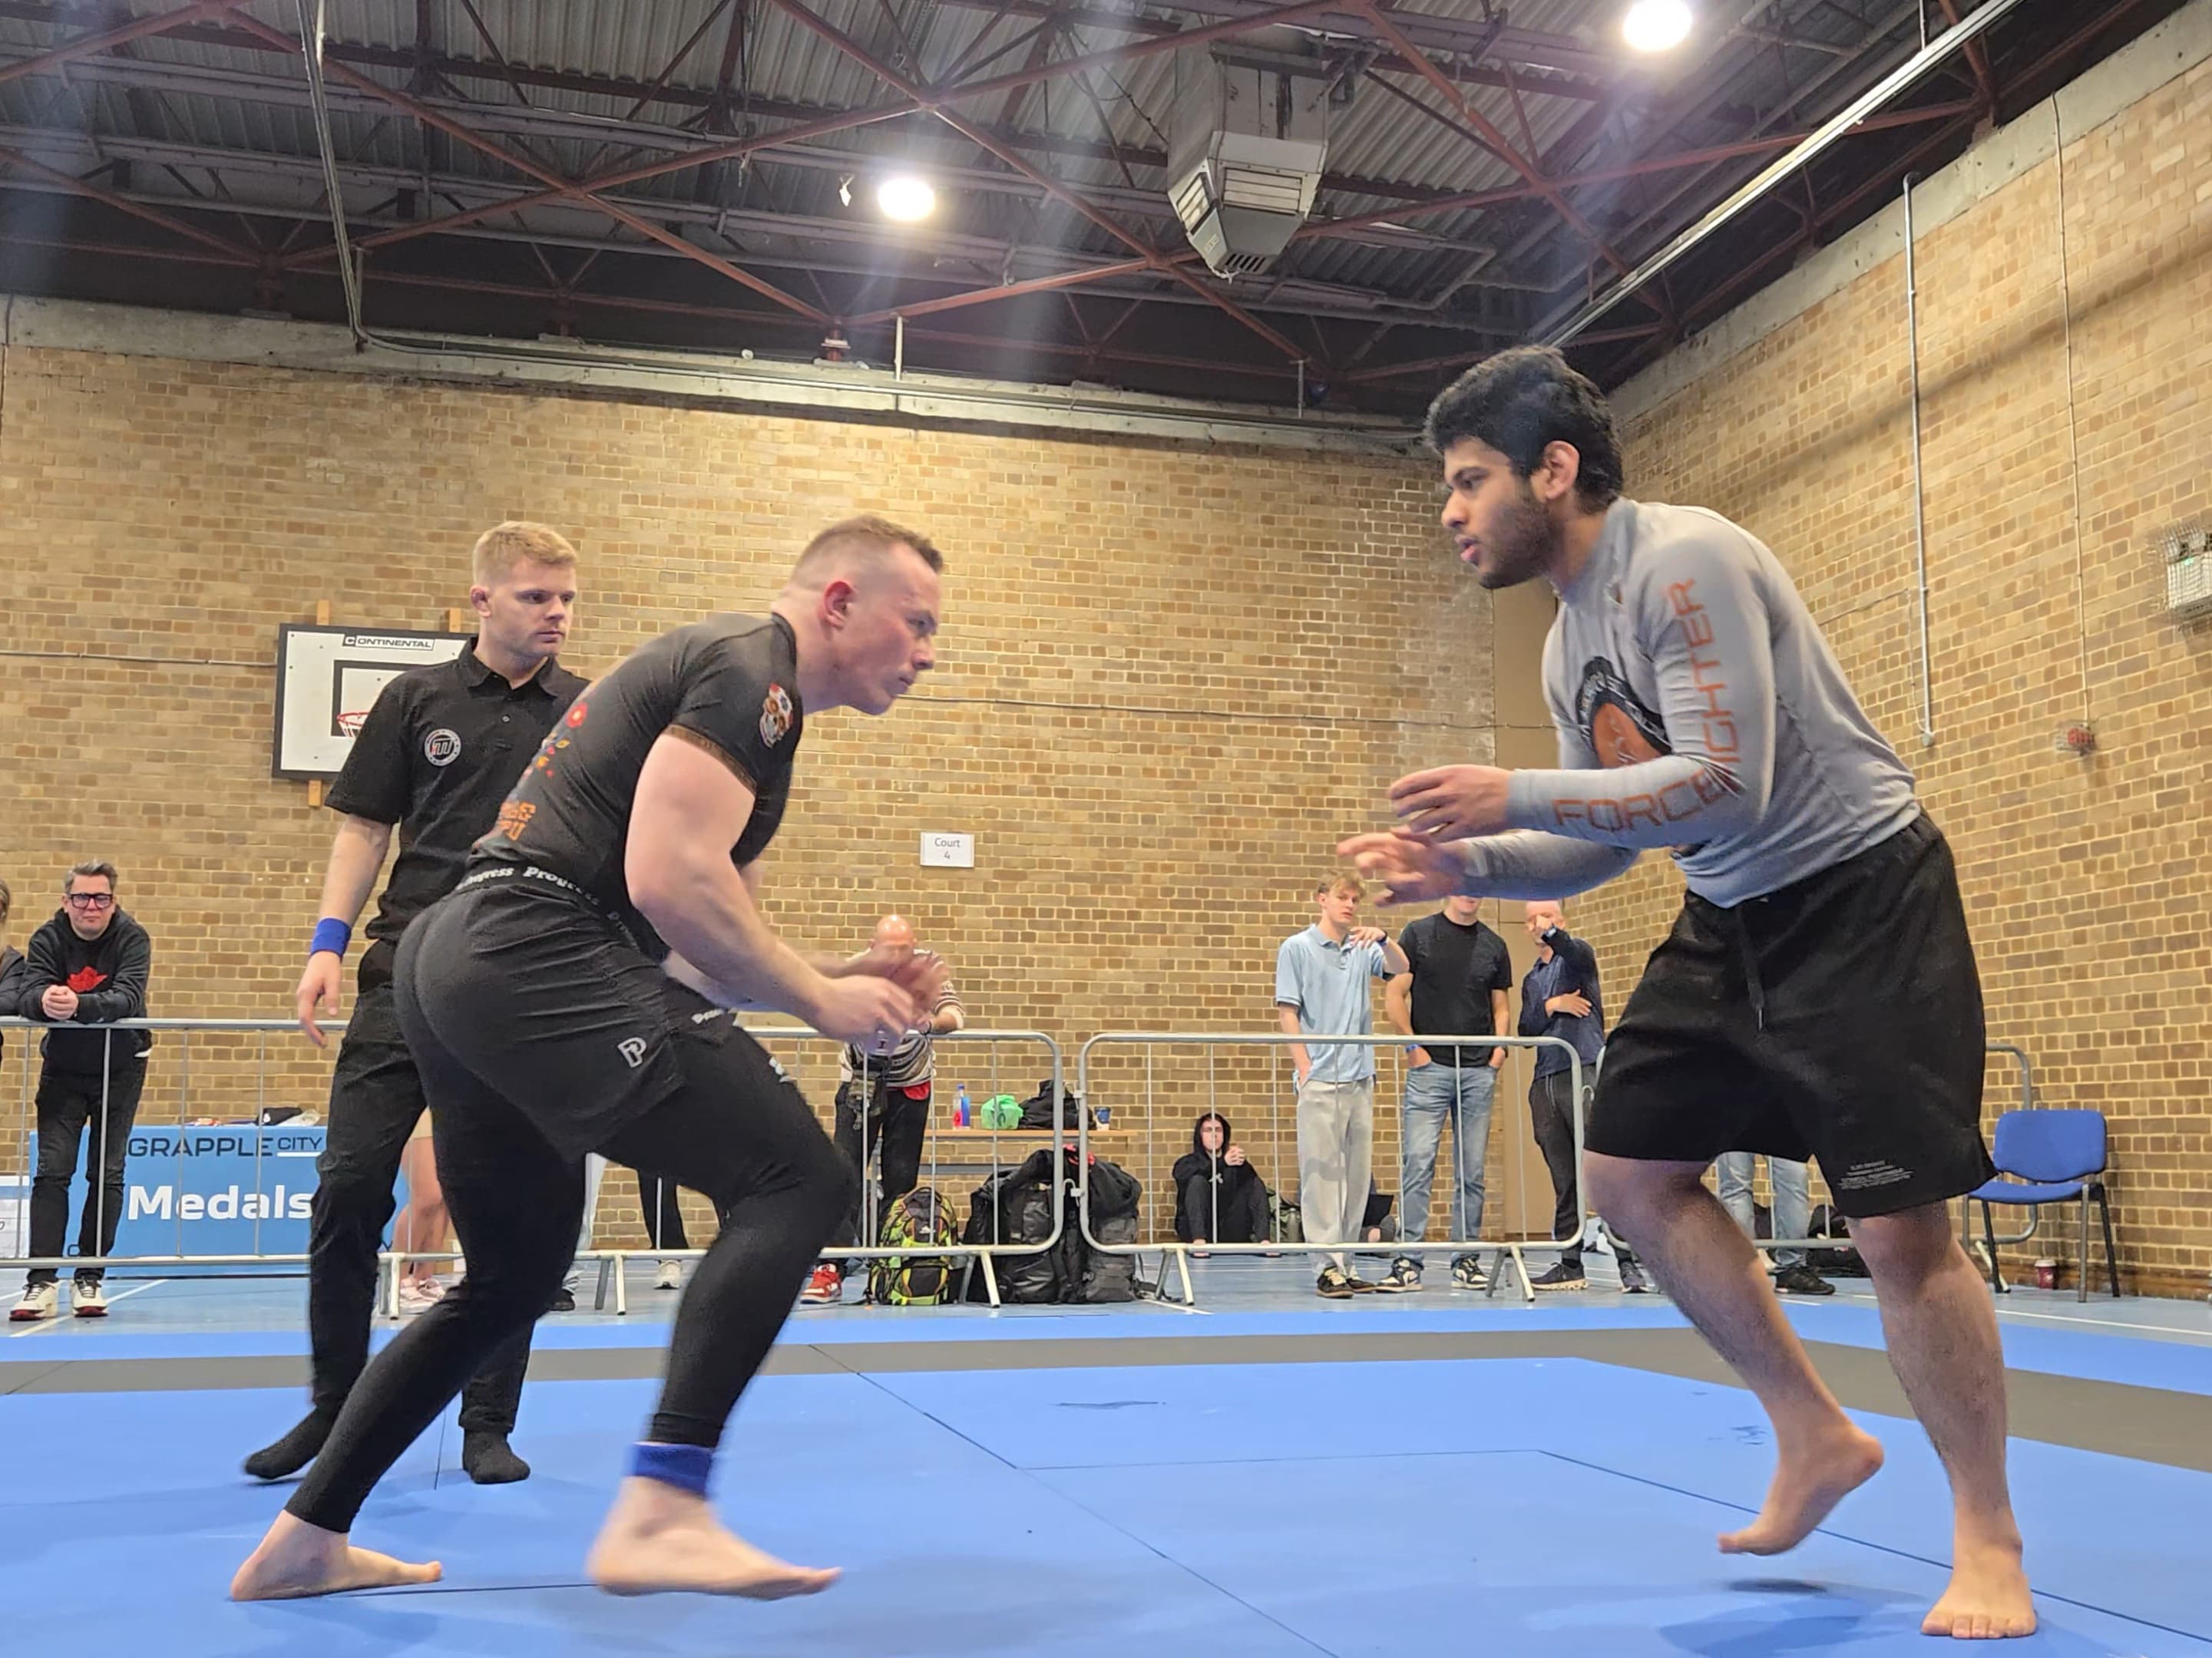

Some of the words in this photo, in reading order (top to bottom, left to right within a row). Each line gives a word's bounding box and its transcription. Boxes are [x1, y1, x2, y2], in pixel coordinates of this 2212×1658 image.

[347, 636, 431, 649] CONTINENTAL
[1666, 578, 1747, 796] IGHTER
[934, 837, 961, 848] Court
[944, 851, 951, 860] 4
[128, 1137, 273, 1157] GRAPPLE
[277, 1136, 322, 1151] CITY
[128, 1184, 312, 1220] Medals
